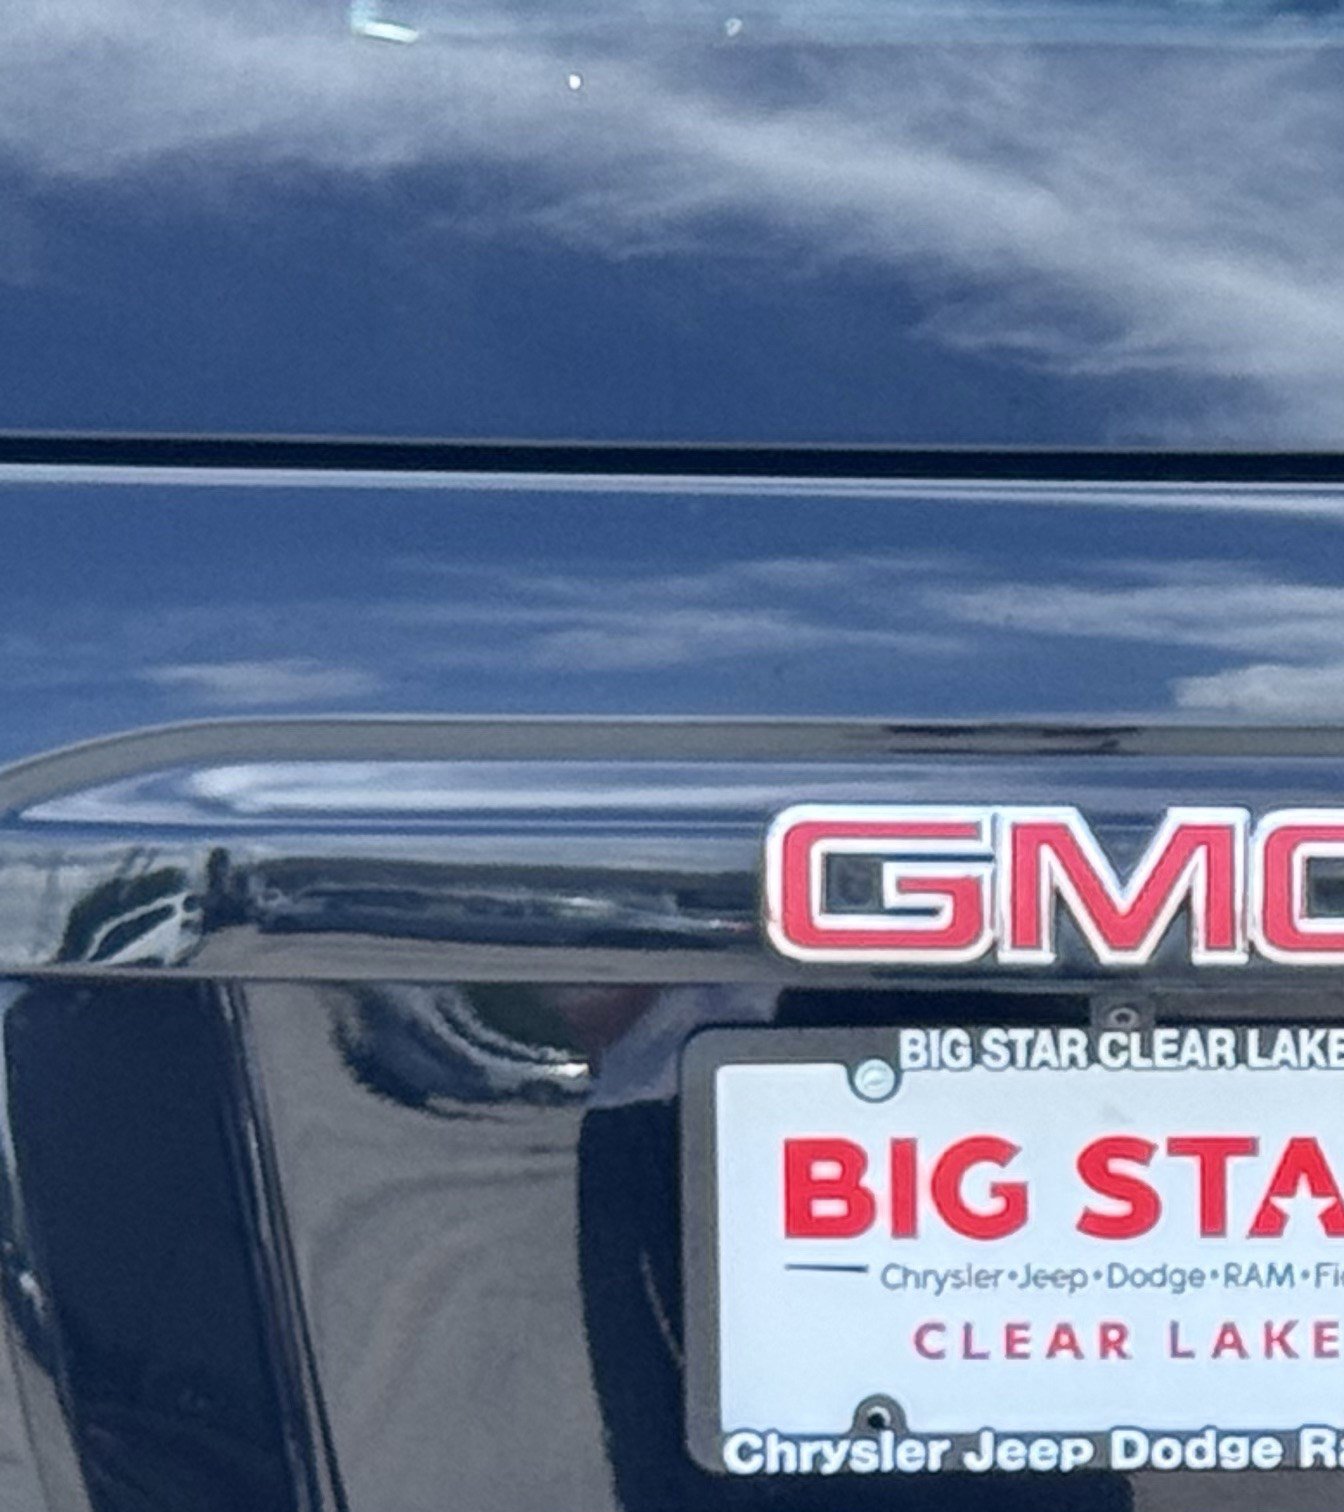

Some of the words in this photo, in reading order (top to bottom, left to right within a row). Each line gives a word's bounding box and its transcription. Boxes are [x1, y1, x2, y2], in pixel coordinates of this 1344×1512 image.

[900, 1028, 972, 1070] BIG
[980, 1028, 1088, 1070] STAR
[1097, 1028, 1237, 1070] CLEAR
[784, 1136, 1028, 1240] BIG
[880, 1262, 1004, 1296] Chrysler
[1017, 1262, 1088, 1295] Jeep
[1106, 1261, 1206, 1295] Dodge
[1223, 1262, 1296, 1288] RAM
[912, 1320, 1133, 1361] CLEAR
[1169, 1320, 1341, 1361] LAKE
[722, 1430, 951, 1475] Chrysler
[962, 1430, 1095, 1473] Jeep
[1110, 1428, 1284, 1470] Dodge
